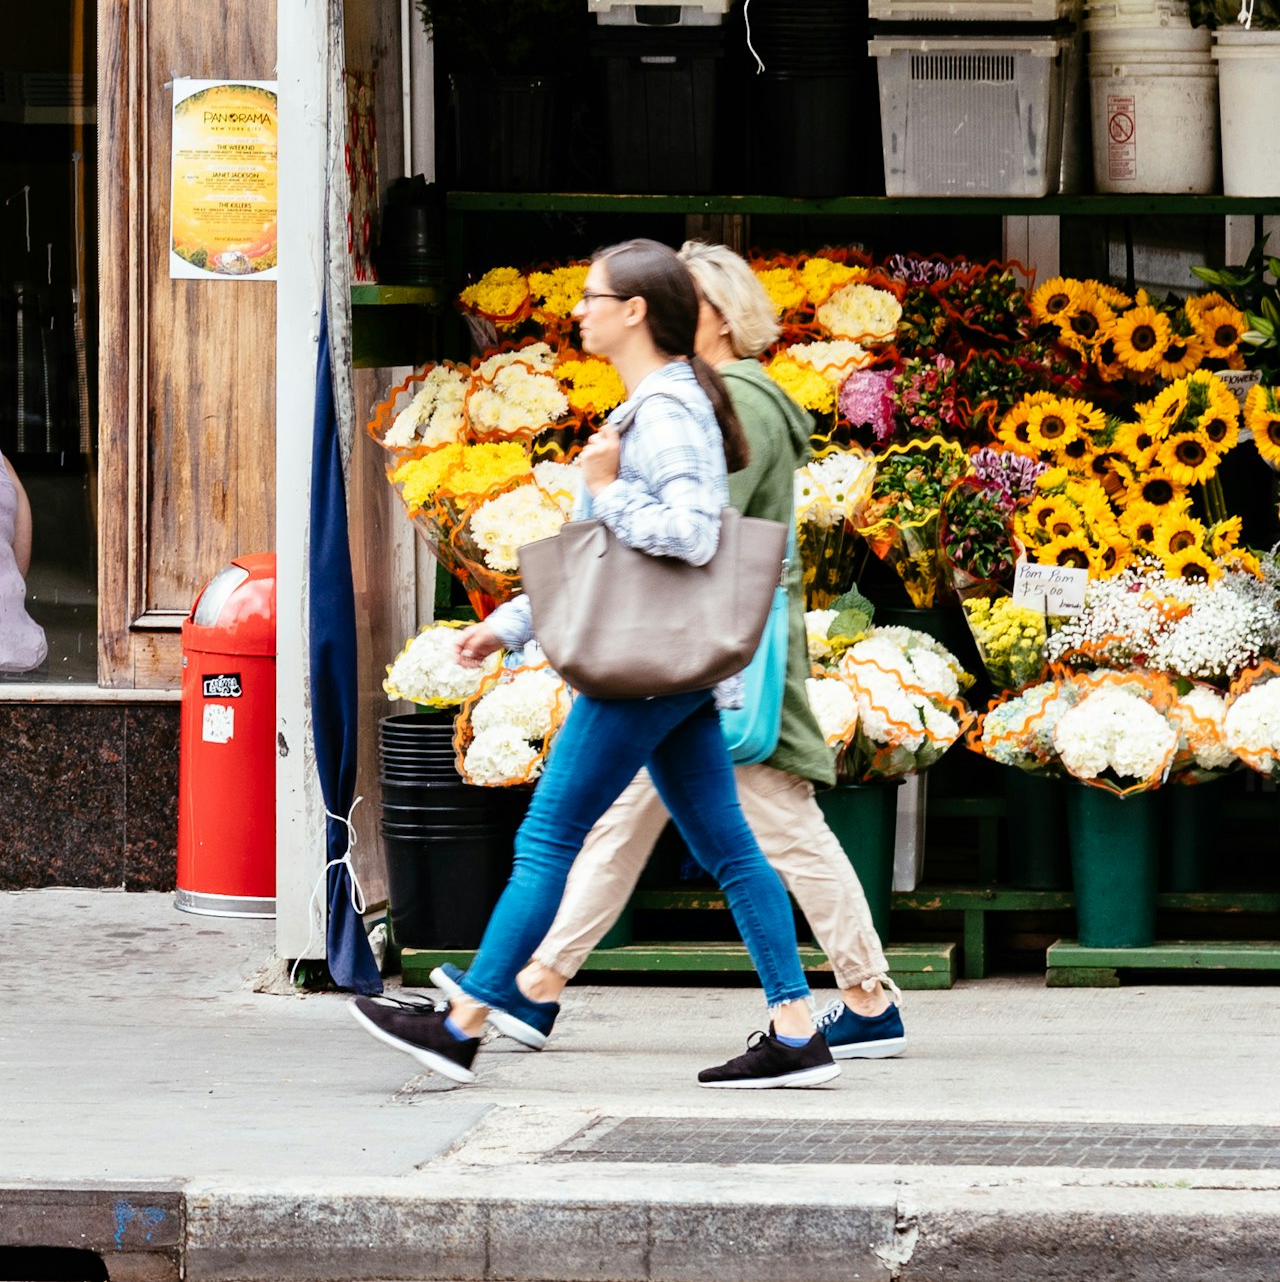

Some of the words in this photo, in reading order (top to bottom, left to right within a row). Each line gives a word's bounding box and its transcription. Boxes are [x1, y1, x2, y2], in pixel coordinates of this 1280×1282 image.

[203, 111, 272, 126] PANORAMA
[1020, 565, 1042, 578] Pom
[1048, 569, 1074, 583] Pom
